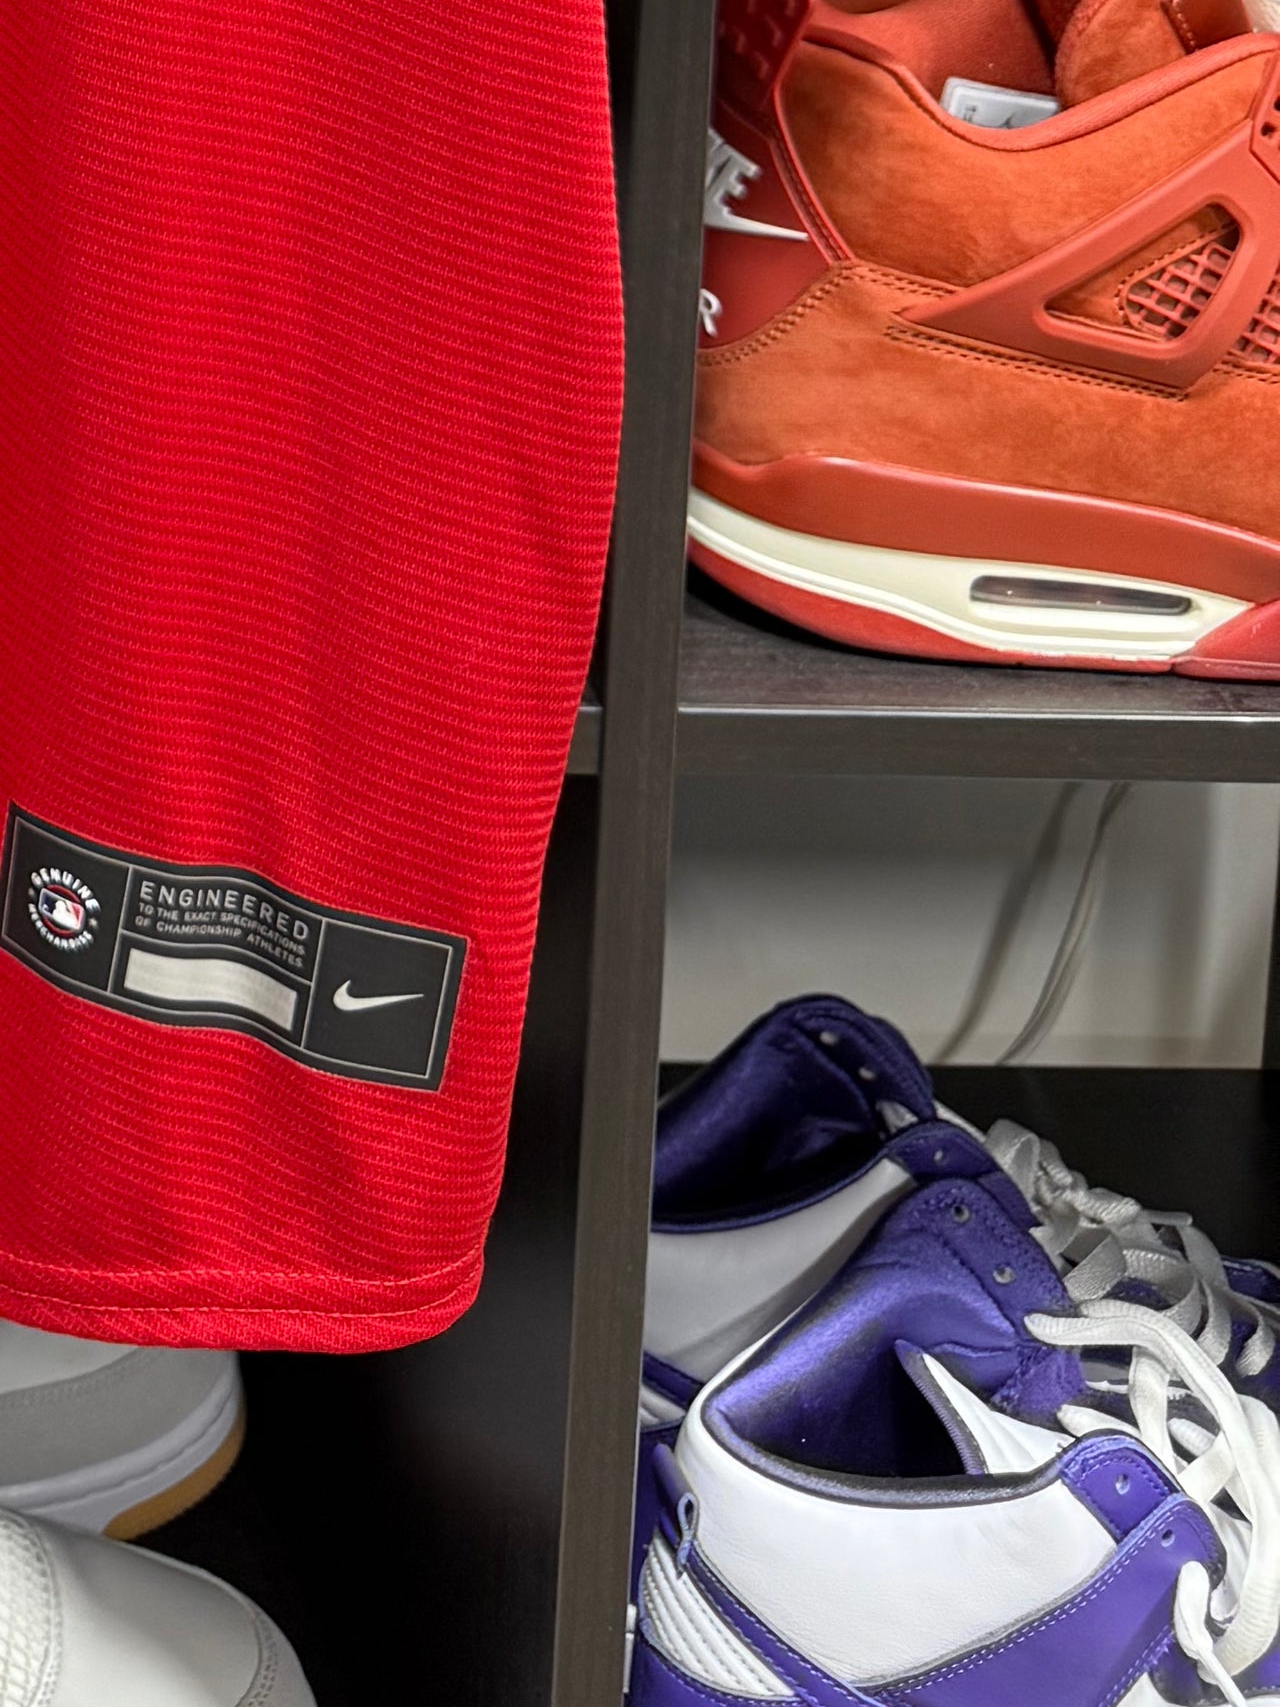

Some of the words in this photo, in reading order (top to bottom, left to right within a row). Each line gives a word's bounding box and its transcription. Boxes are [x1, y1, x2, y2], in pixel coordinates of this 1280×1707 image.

[30, 867, 101, 912] GENUINE
[140, 880, 310, 940] ENGINEERED
[135, 915, 151, 928] OF
[156, 921, 242, 937] CHAMPIONSHIP
[139, 902, 154, 915] TO
[157, 907, 179, 921] THE
[184, 910, 217, 922] EXACT
[220, 912, 306, 955] SPECIFICATIONS
